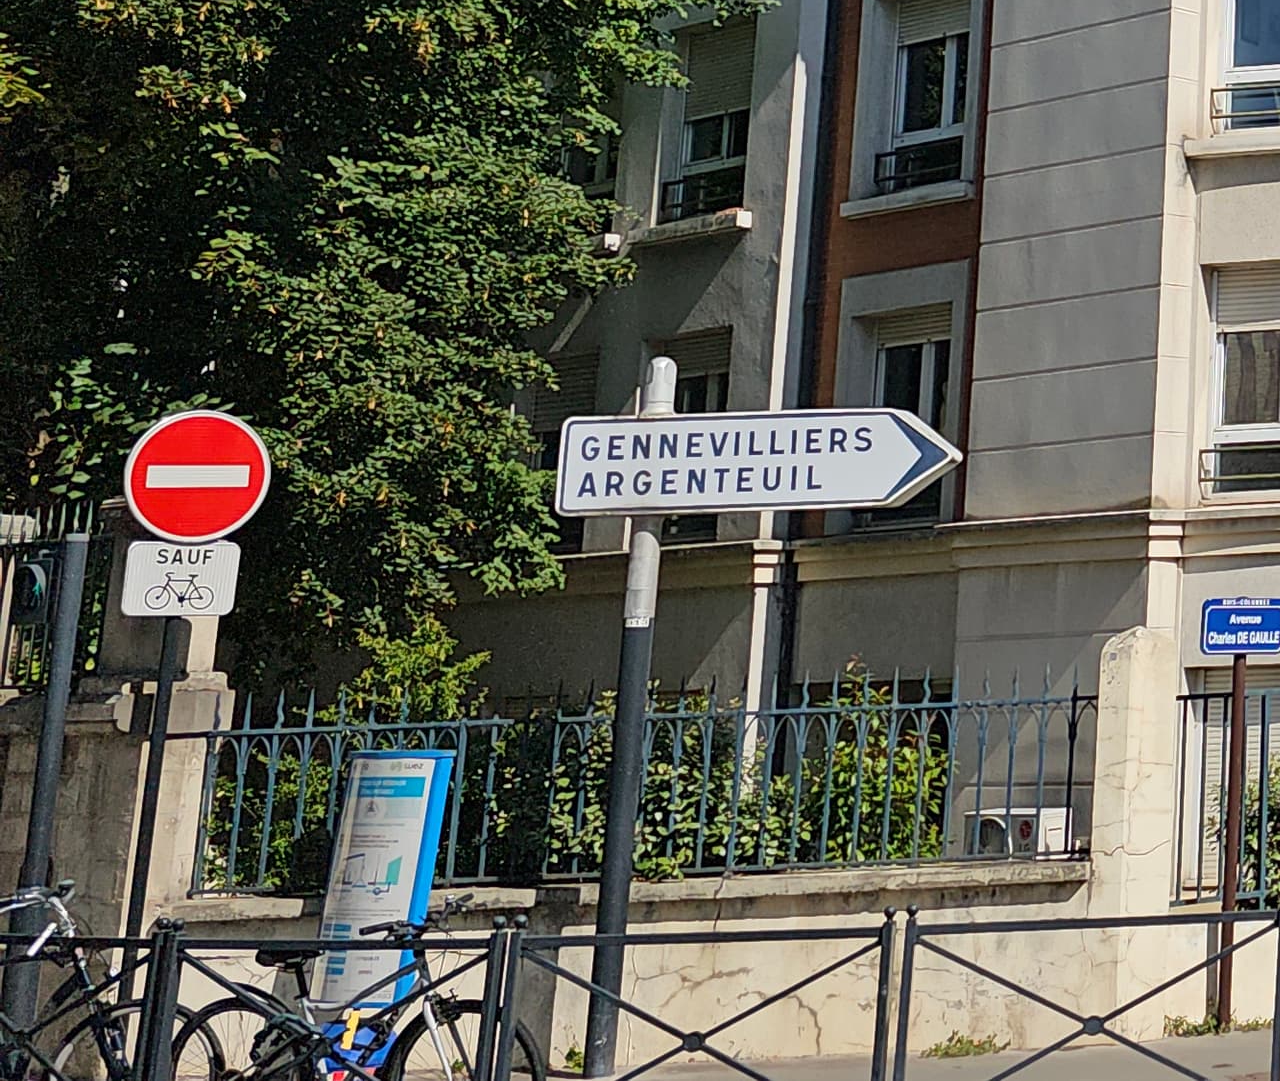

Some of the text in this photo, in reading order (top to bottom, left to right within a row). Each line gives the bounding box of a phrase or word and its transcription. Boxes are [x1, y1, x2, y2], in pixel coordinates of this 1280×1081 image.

[580, 426, 874, 462] GENNEVILLIERS
[576, 464, 823, 498] ARGENTEUIL
[156, 548, 215, 566] SAUF
[1229, 614, 1262, 624] Avenue
[1208, 630, 1280, 645] Charles DE GAULLE
